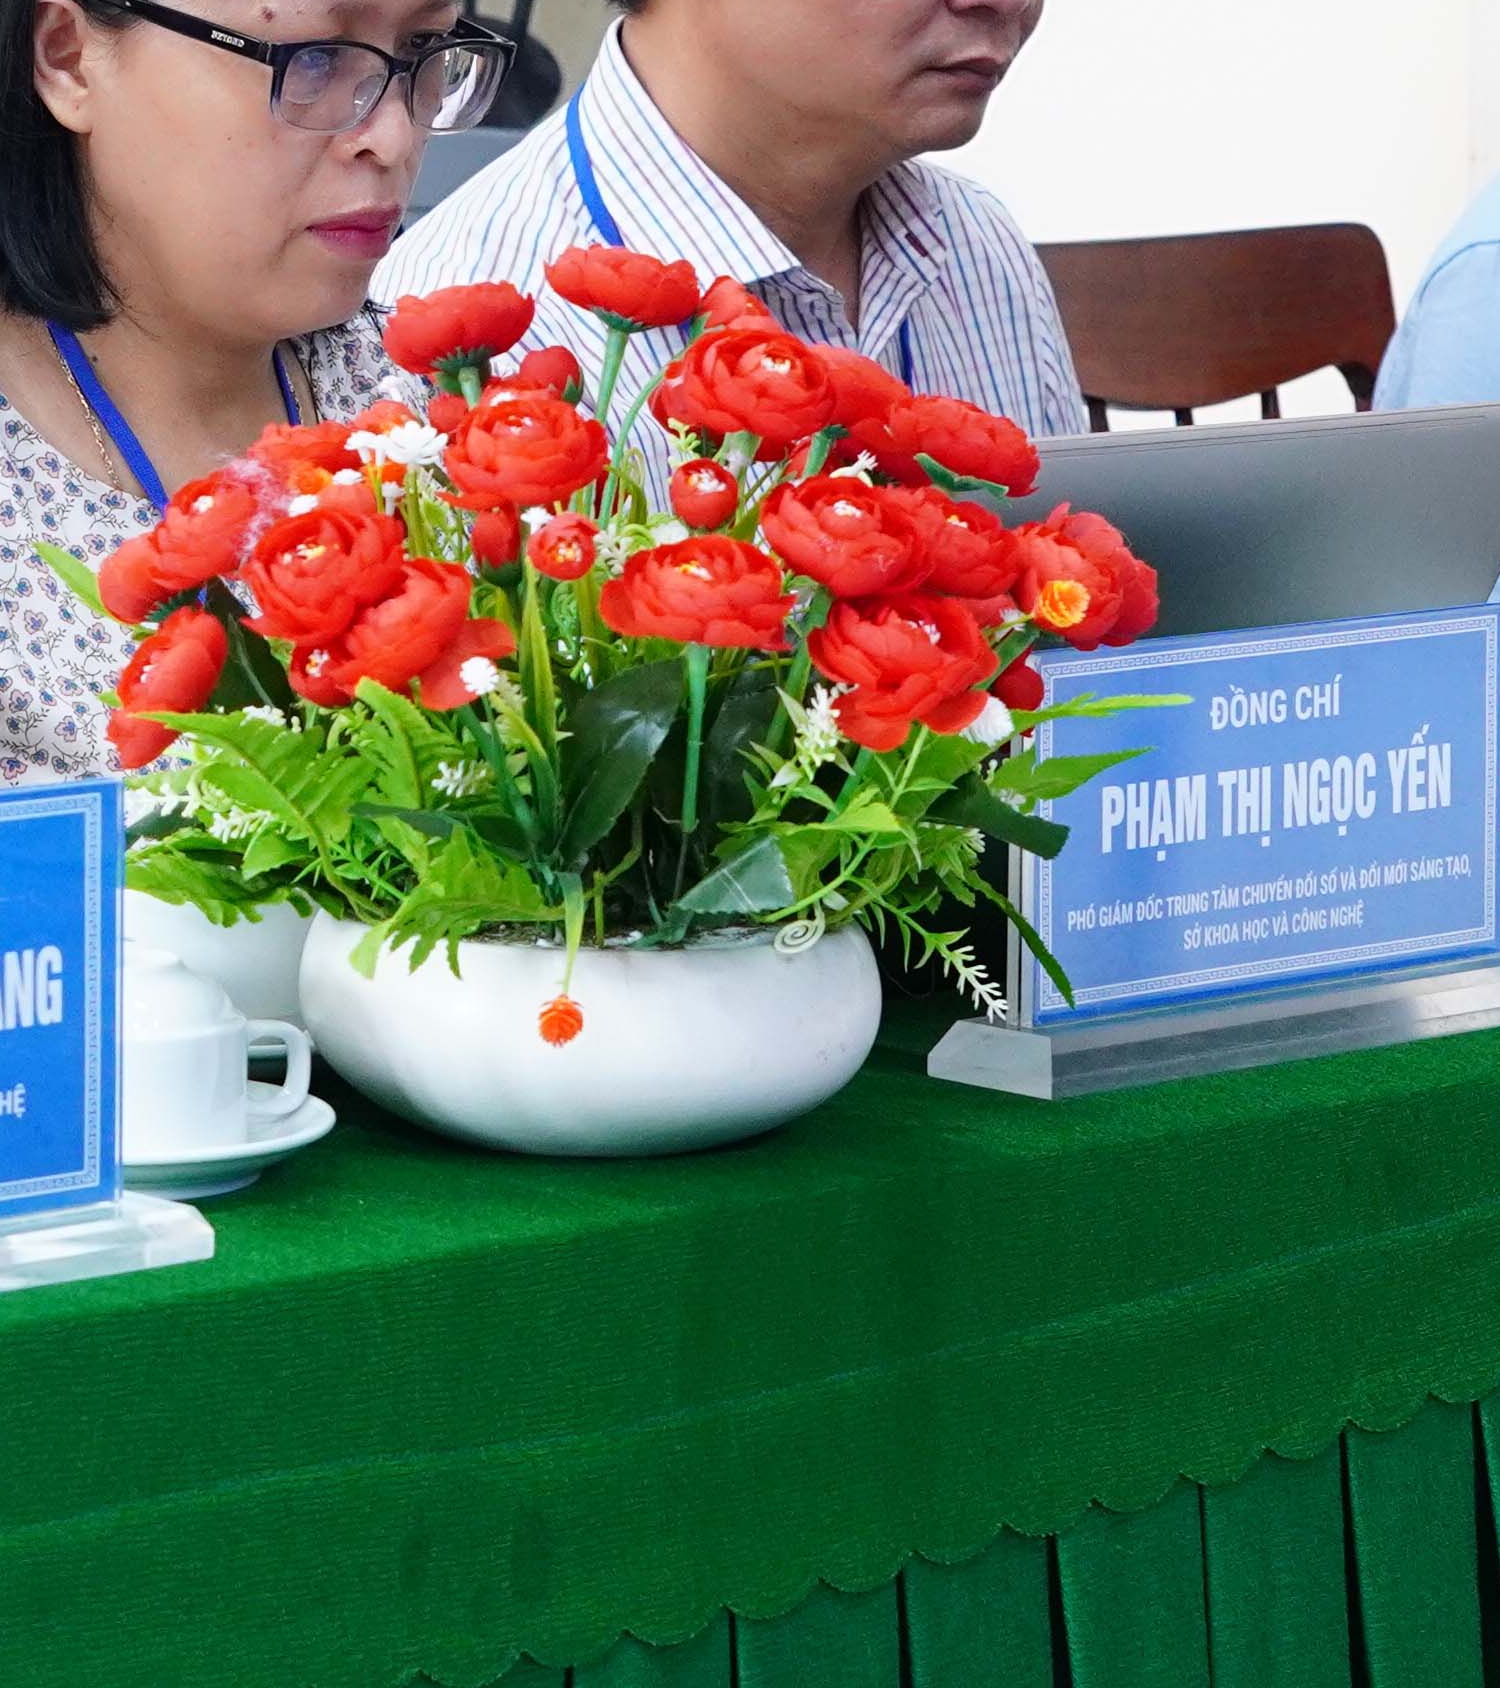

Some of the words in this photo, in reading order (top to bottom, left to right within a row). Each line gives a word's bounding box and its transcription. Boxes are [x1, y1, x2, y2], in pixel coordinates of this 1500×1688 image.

[1210, 685, 1287, 730] ĐỒNG
[1295, 673, 1342, 720] CHÍ
[1102, 773, 1207, 862] PHẠM
[1218, 766, 1271, 847] THỊ
[1284, 752, 1376, 836] NGỌC
[1387, 723, 1451, 814] YẾN
[1068, 903, 1095, 932] PHÓ
[1099, 900, 1133, 928] GIÁM
[1136, 894, 1163, 921] ĐỐC
[1166, 891, 1209, 917] TRUNG
[1212, 884, 1239, 910] TÂM
[1242, 874, 1292, 906] CHUYỂN
[1296, 870, 1317, 898] ĐỔI
[1320, 867, 1337, 894] SỐ
[1340, 866, 1356, 892] VÀ
[1359, 861, 1380, 889] ĐỔI
[1384, 859, 1407, 886] MỚI
[1411, 856, 1443, 882] SÁNG
[1446, 854, 1471, 880] TẠO,
[1184, 922, 1202, 950] SỞ
[1204, 922, 1239, 947] KHOA
[1243, 918, 1269, 943] HỌC
[1272, 910, 1288, 936] VÀ
[1292, 907, 1329, 934] CÔNG
[1330, 899, 1363, 928] NGHỆ
